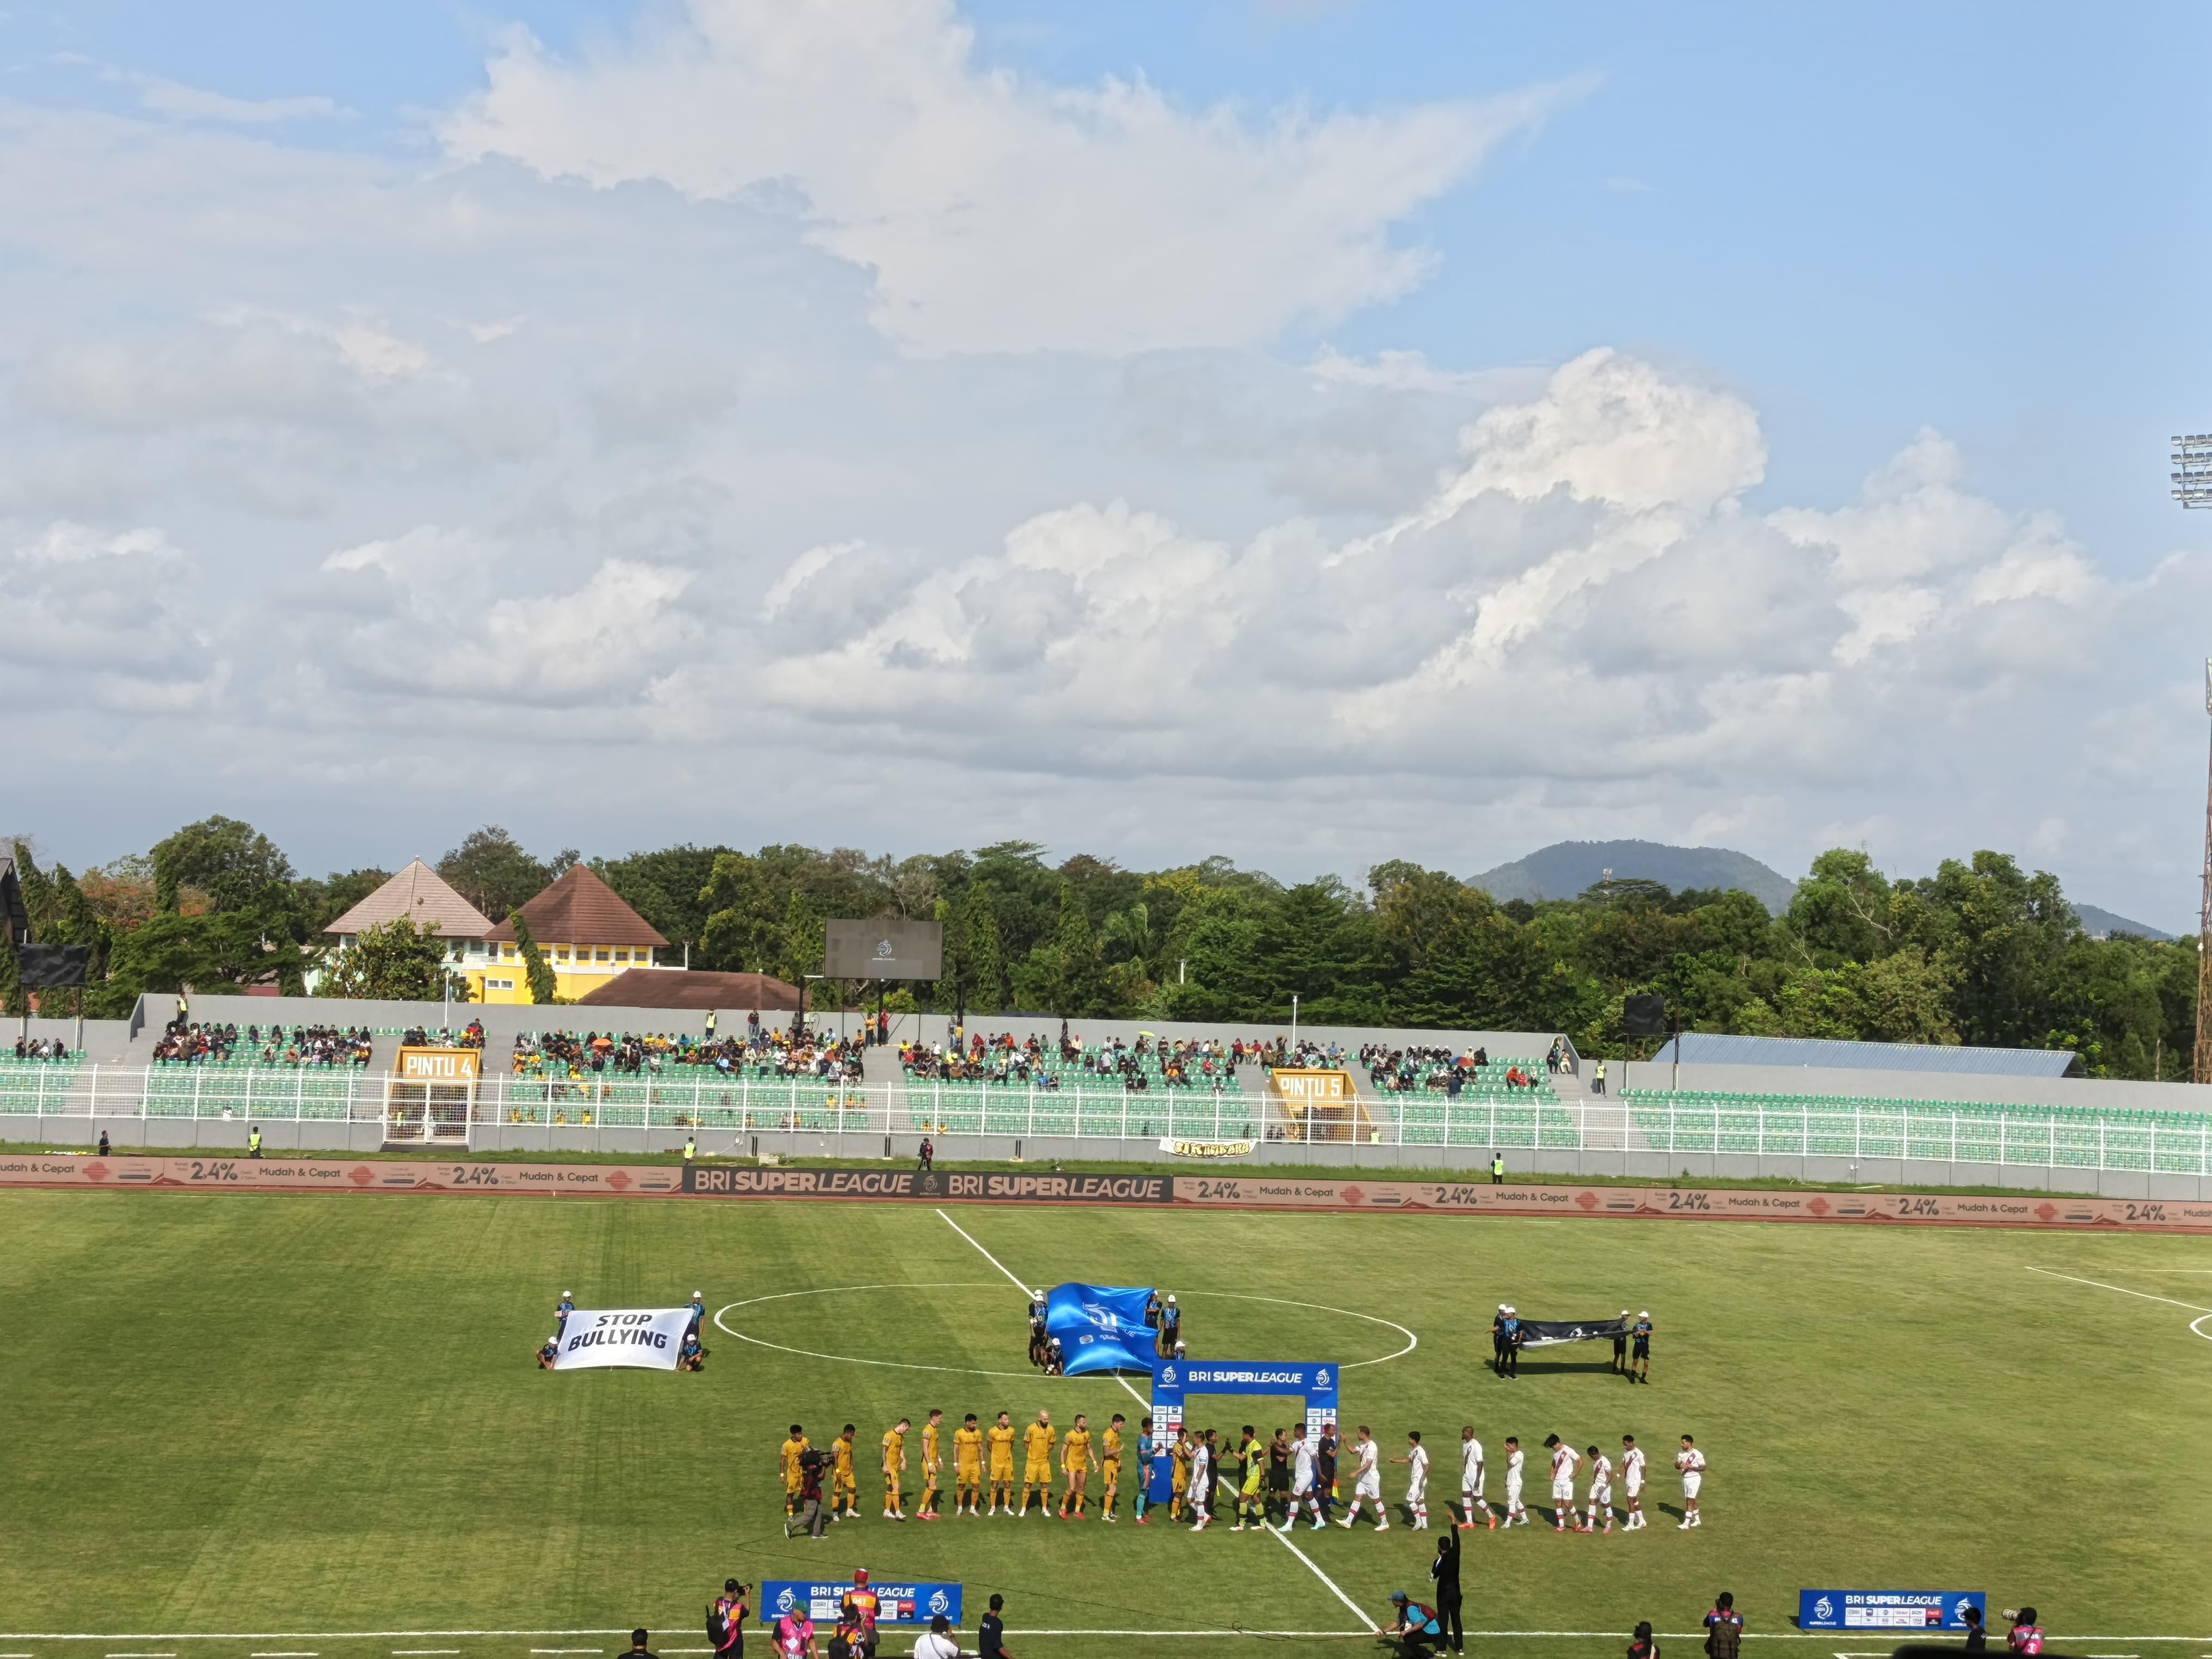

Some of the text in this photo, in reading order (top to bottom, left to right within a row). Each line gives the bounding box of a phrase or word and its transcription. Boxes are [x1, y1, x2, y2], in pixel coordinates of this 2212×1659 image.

[407, 1056, 471, 1077] PINTU 4
[1280, 1077, 1341, 1097] PINTU 5
[31, 1164, 38, 1172] &
[42, 1164, 75, 1175] Cepat
[260, 1168, 294, 1177] Mudah
[298, 1168, 305, 1177] &
[309, 1168, 341, 1179] Cepat
[520, 1172, 554, 1181] Mudah
[557, 1173, 564, 1181] &
[568, 1172, 598, 1183] Cepat
[695, 1171, 730, 1190] BRI
[949, 1175, 983, 1195] BRI
[1259, 1187, 1292, 1196] Mudah
[1295, 1188, 1301, 1196] &
[1304, 1187, 1334, 1198] Cepat
[1496, 1191, 1527, 1201] Mudah
[1530, 1193, 1537, 1201] &
[1540, 1193, 1568, 1203] Cepat
[1729, 1197, 1760, 1207] Mudah
[1762, 1198, 1769, 1207] &
[1772, 1199, 1801, 1209] Cepat
[1958, 1203, 1988, 1212] Mudah
[1991, 1204, 1998, 1212] &
[2000, 1205, 2028, 1214] Cepat
[596, 1314, 653, 1327] STOP
[568, 1329, 667, 1351] BULLYING
[1189, 1371, 1211, 1382] BRI
[811, 1587, 831, 1596] BRI
[1845, 1595, 1864, 1604] BRI
